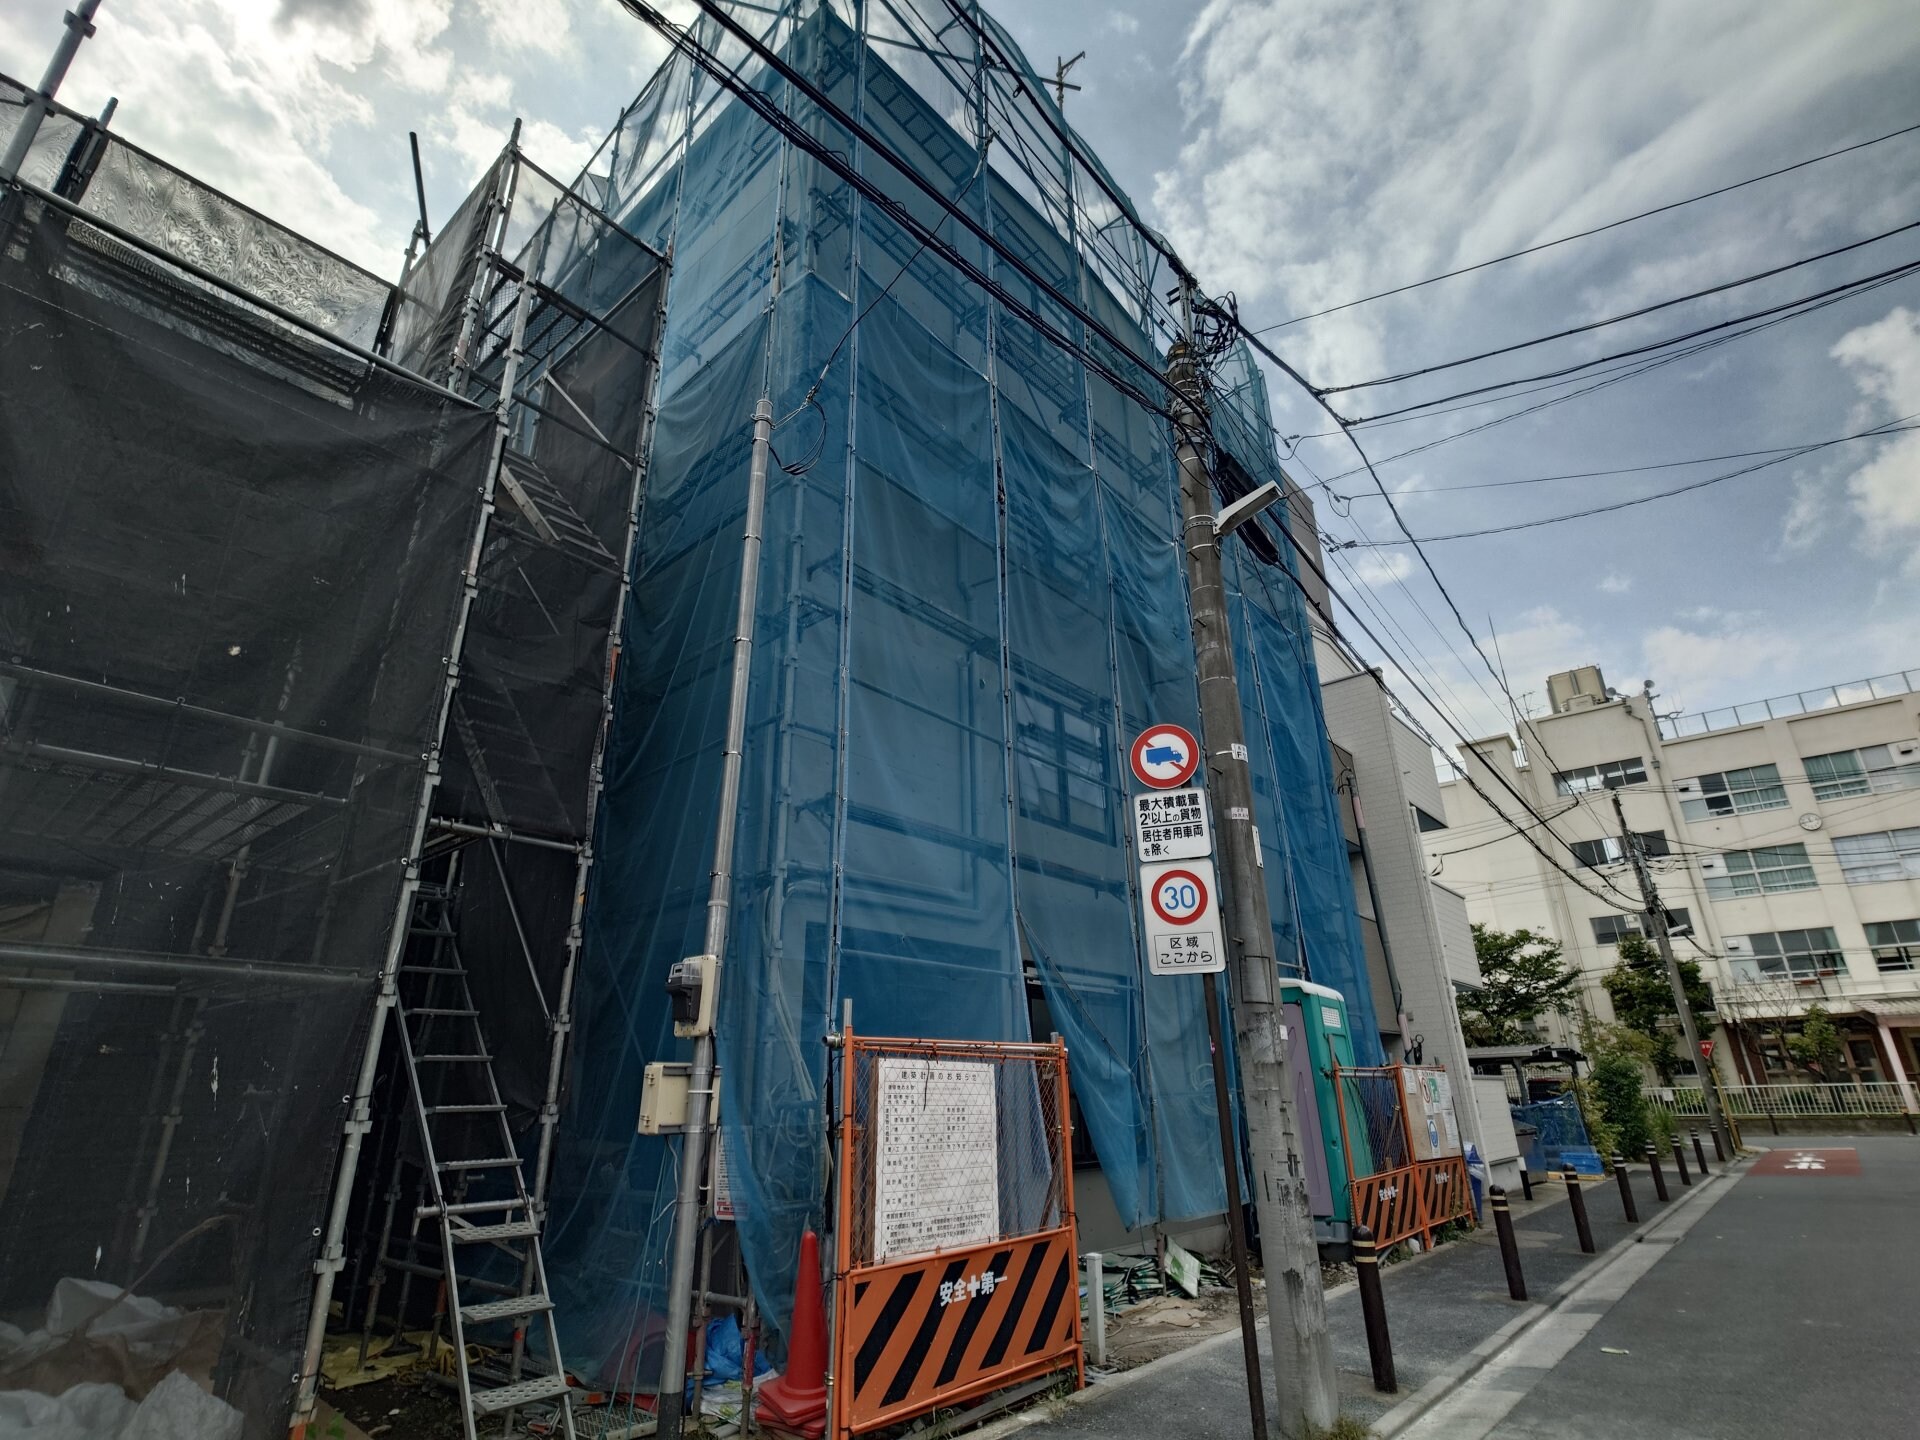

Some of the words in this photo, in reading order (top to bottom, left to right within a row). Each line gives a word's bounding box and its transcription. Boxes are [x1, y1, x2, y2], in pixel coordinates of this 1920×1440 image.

[1139, 793, 1200, 811] 最大積載量
[1142, 824, 1204, 843] 居住者用車両
[1143, 843, 1170, 857] を除く
[1164, 884, 1196, 910] 30
[1169, 936, 1200, 949] 区域
[1160, 951, 1213, 965] ここから
